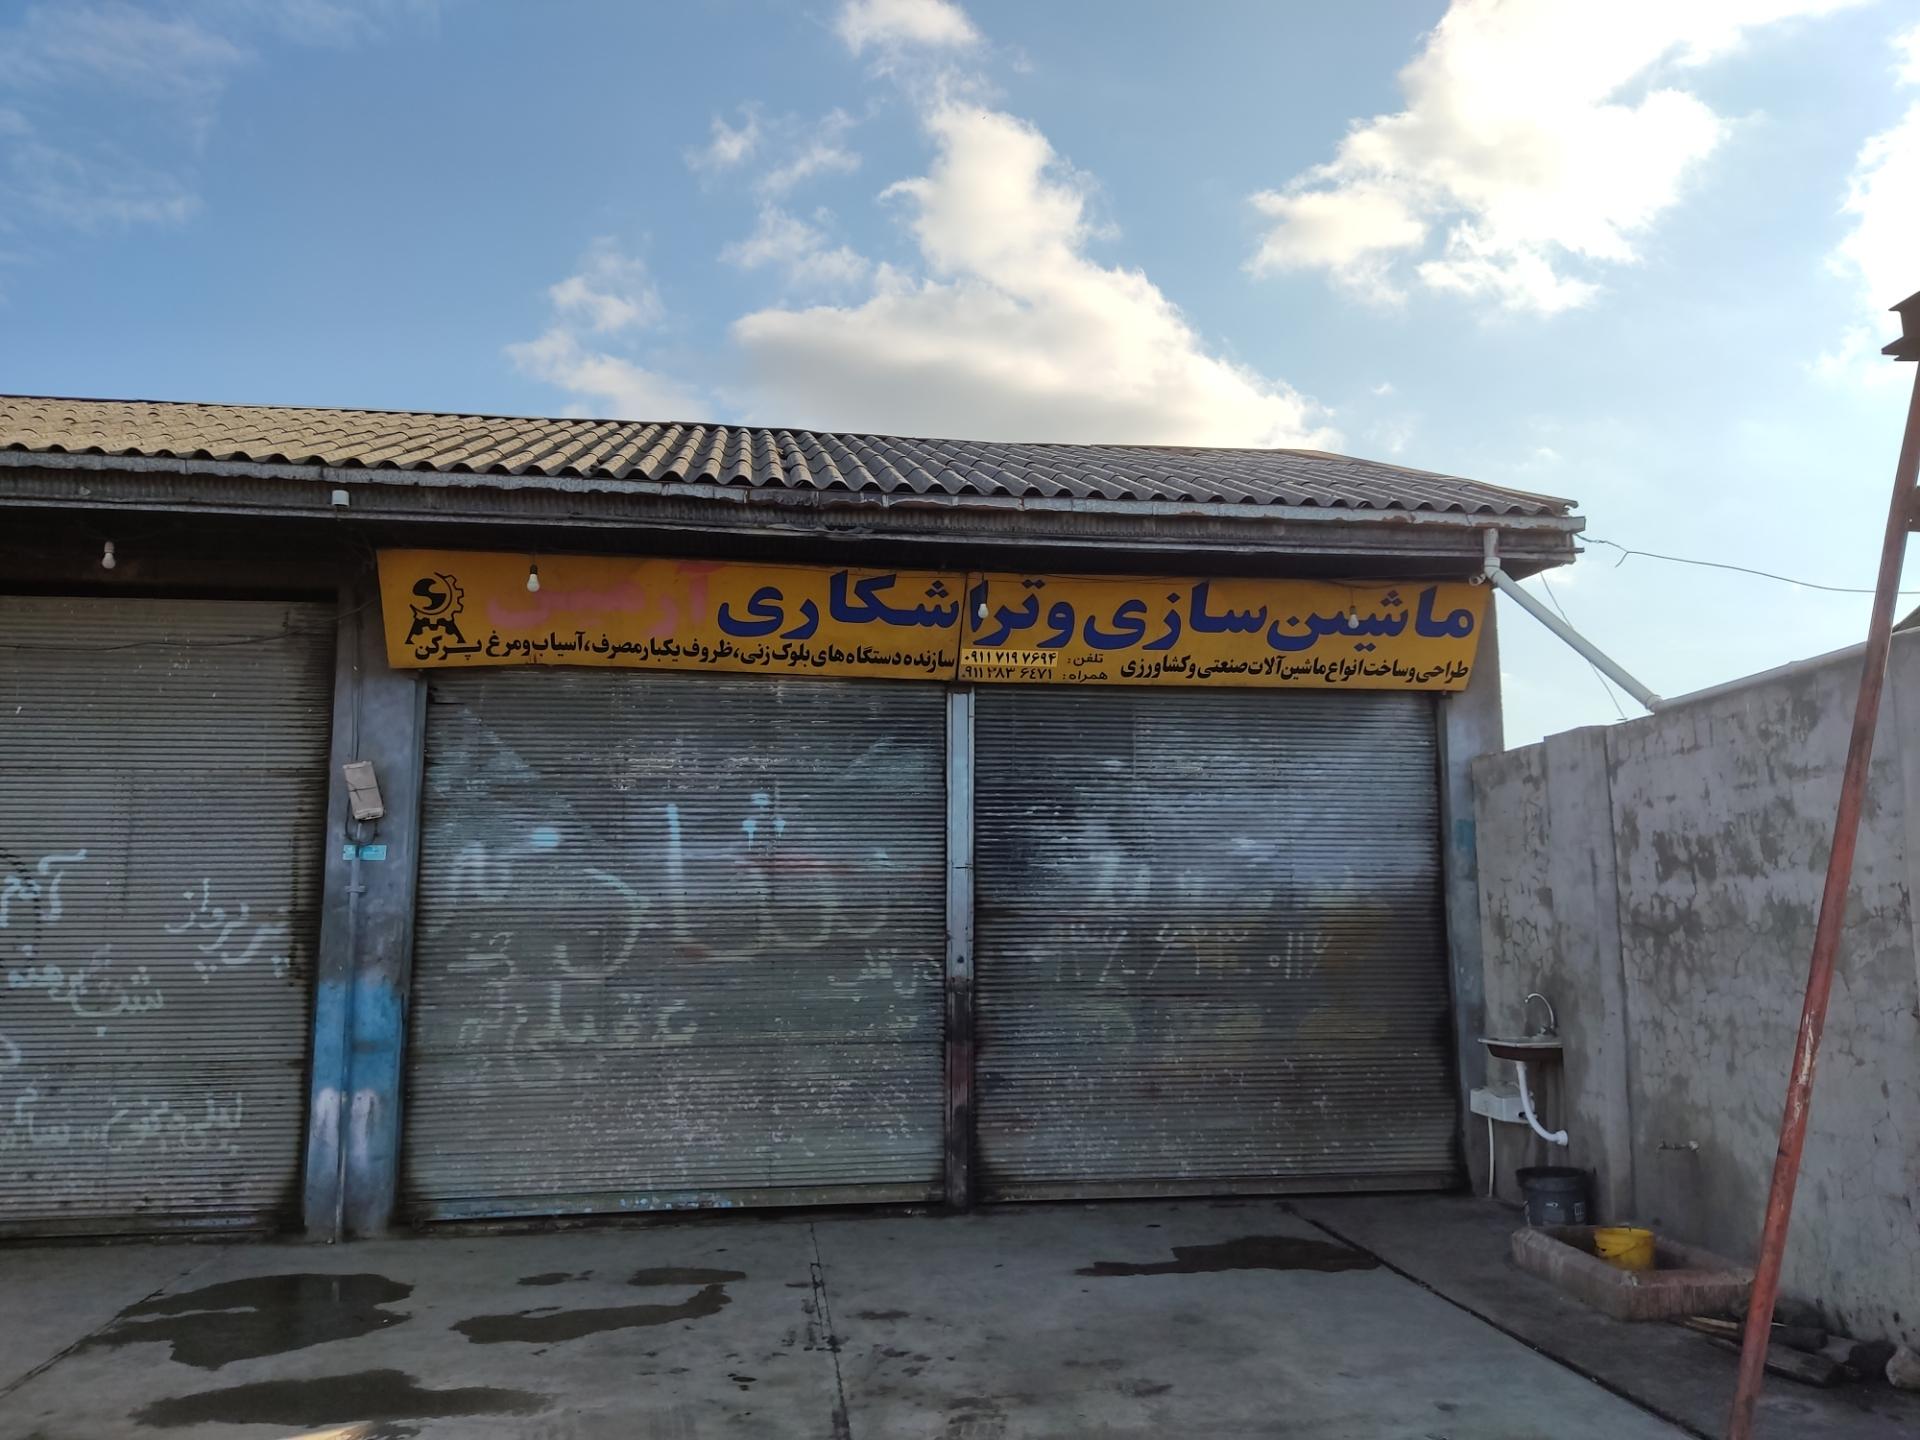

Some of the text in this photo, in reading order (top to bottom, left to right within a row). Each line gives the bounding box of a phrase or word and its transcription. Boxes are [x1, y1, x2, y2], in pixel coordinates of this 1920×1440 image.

[1083, 580, 1268, 650] سازی
[1266, 585, 1474, 652] ماشین
[531, 630, 586, 657] آسیاب
[683, 638, 734, 663] ظروف
[904, 649, 955, 673] سازنده
[1197, 658, 1248, 679] صنعتی
[1248, 655, 1287, 675] آلات
[1280, 656, 1326, 680] ماشین
[1324, 657, 1363, 683] انواع
[1416, 660, 1469, 684] طراحی
